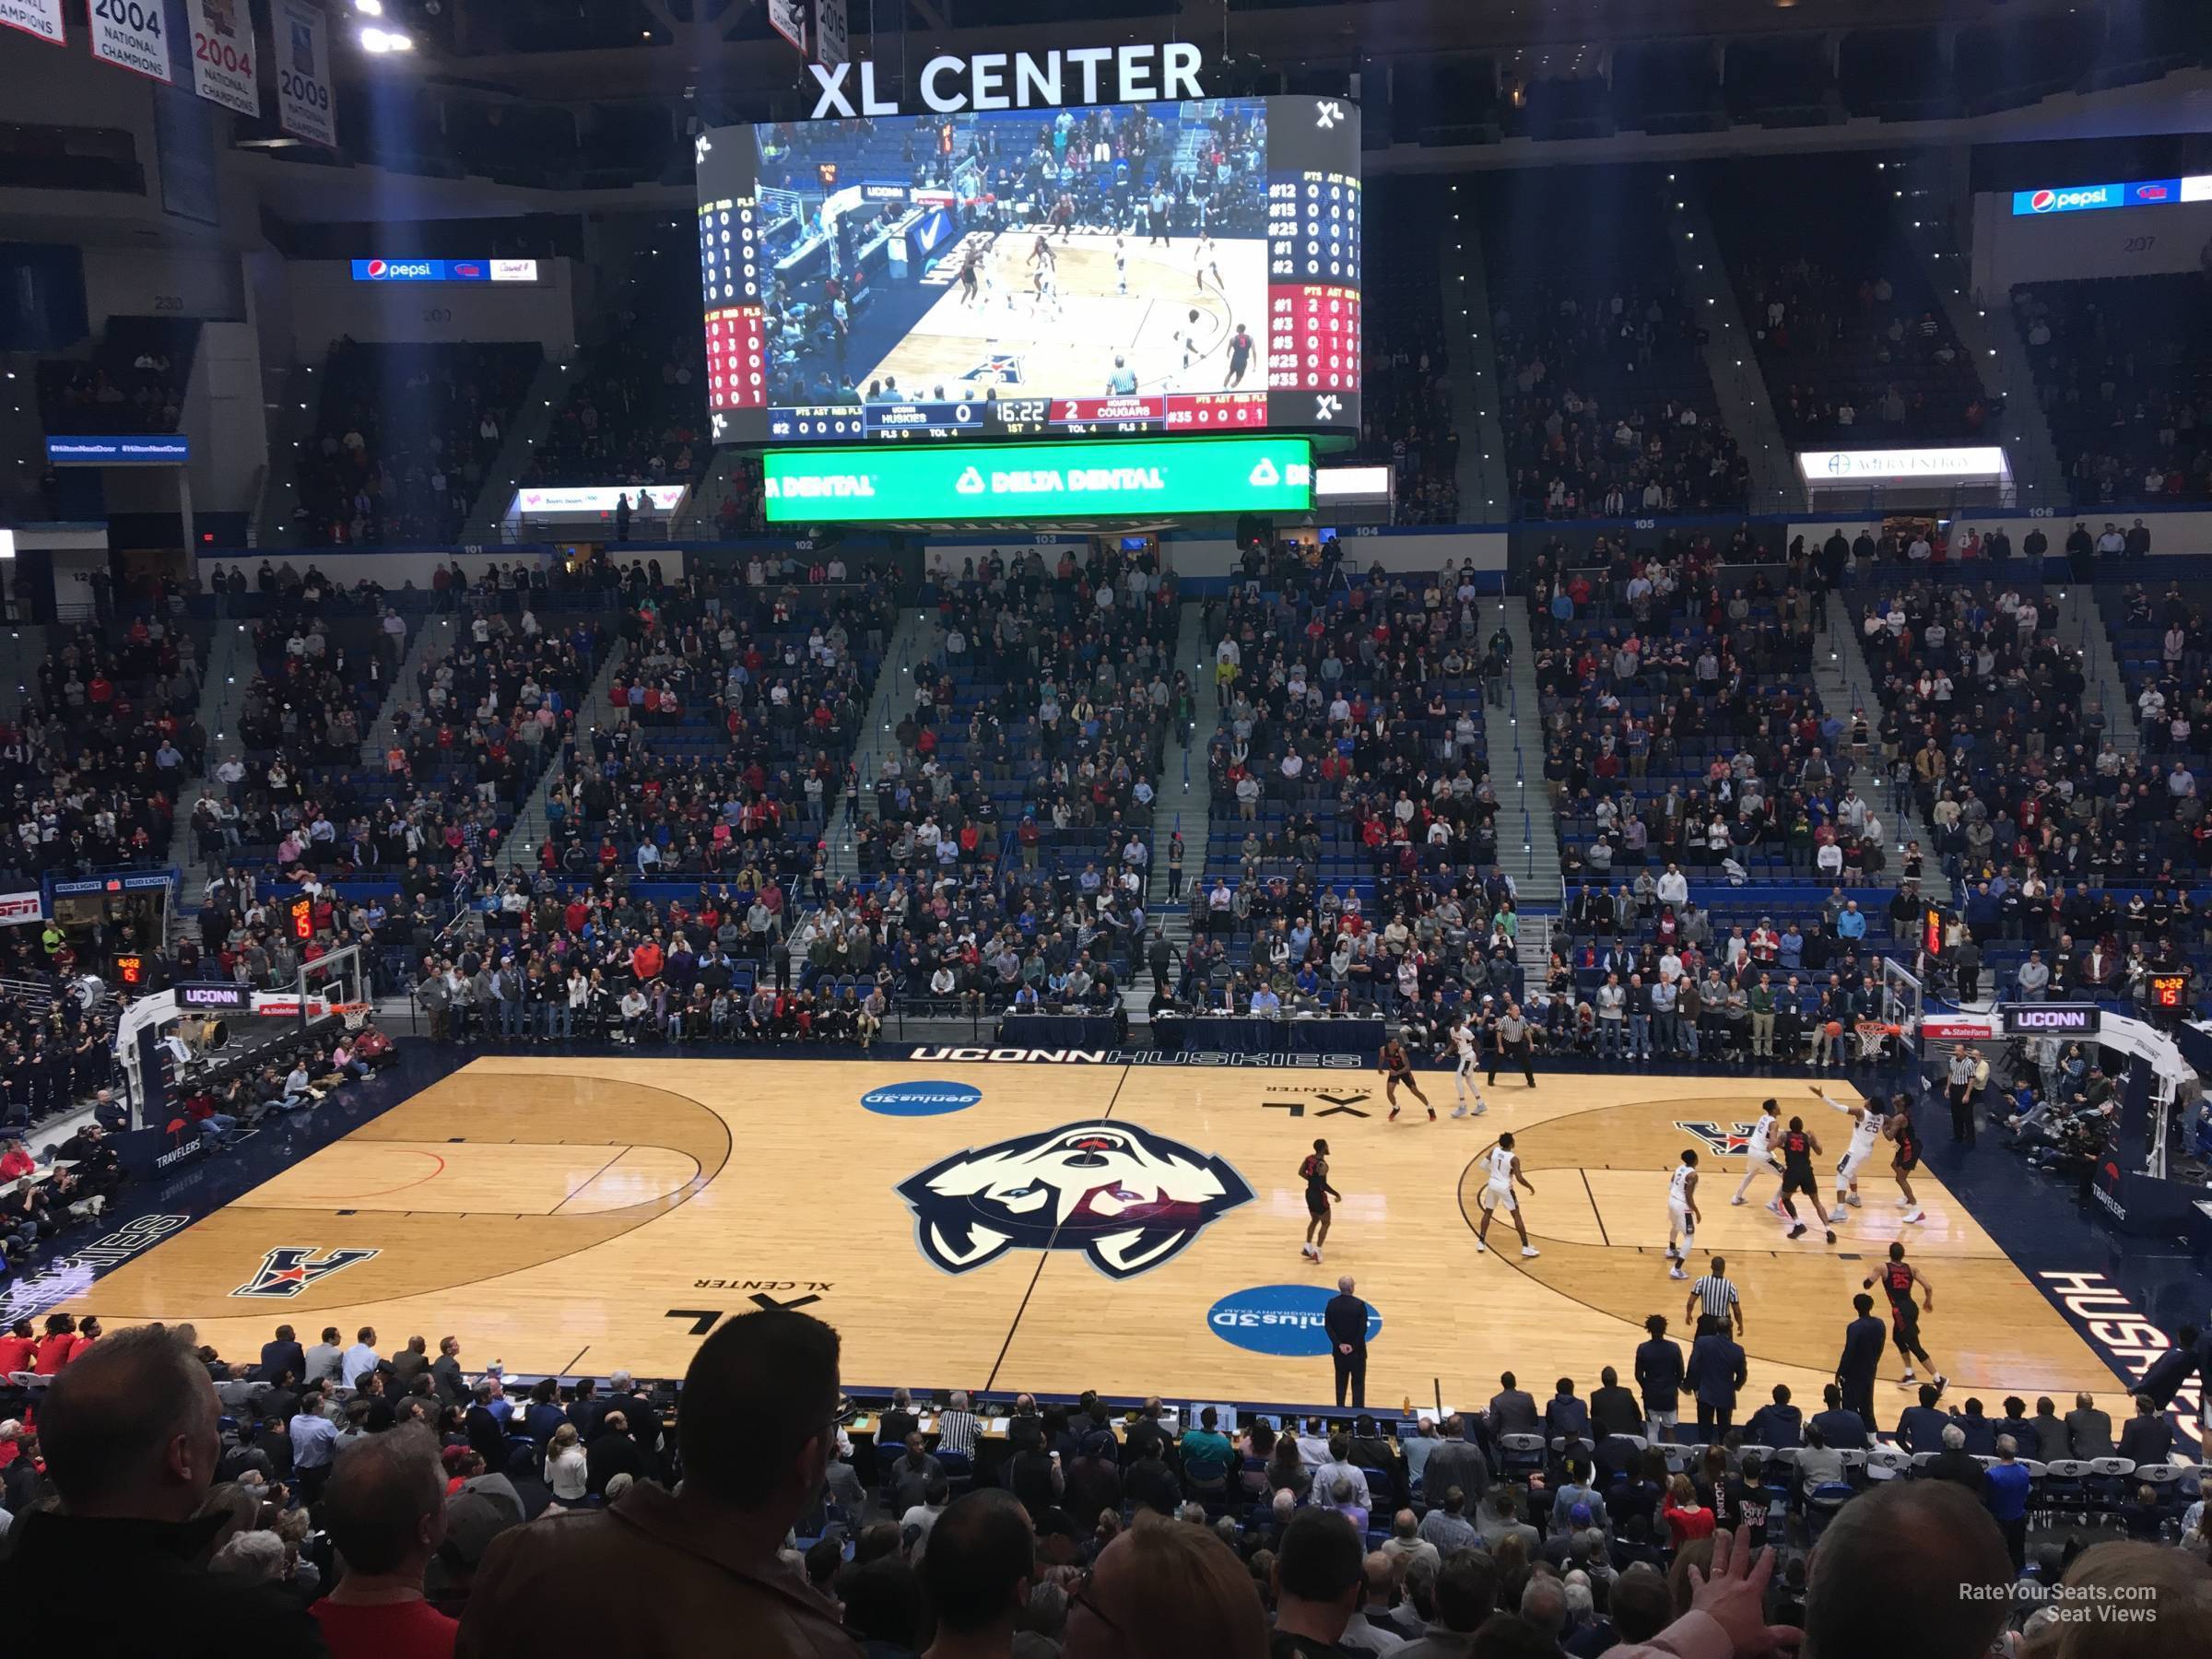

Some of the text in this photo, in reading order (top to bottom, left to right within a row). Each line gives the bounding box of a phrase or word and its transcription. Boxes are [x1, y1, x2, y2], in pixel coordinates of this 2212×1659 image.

[96, 0, 161, 39] 2004
[104, 26, 158, 56] NATIONAL
[102, 43, 164, 76] CHAMPIONS
[195, 32, 252, 78] 2004
[205, 68, 249, 94] NATIONAL
[807, 61, 899, 119] XL
[920, 42, 1206, 113] CENTER
[281, 70, 328, 111] 2009
[202, 84, 254, 112] CHAMPIONS
[1316, 100, 1344, 128] XL
[1304, 171, 1343, 183] PTS AST
[1269, 184, 1319, 198] #12 0
[737, 197, 754, 207] FLS
[2057, 188, 2107, 209] pepsi
[1269, 203, 1319, 218] #15 0
[1268, 222, 1319, 236] #25 0
[1275, 241, 1319, 255] #1 0
[2124, 236, 2156, 252] 207
[390, 263, 431, 278] pepsi
[1273, 260, 1319, 274] #2 0
[1304, 287, 1342, 298] PTS AST
[744, 307, 760, 317] FLS
[1275, 299, 1318, 312] #1 2
[749, 319, 756, 332] 1
[1273, 317, 1293, 331] #3
[1273, 335, 1337, 350] #5 1
[1269, 354, 1298, 368] #25
[1269, 372, 1298, 386] #35
[753, 390, 760, 404] 1
[1107, 399, 1140, 407] HOUSTON
[1196, 395, 1211, 405] PTS
[1215, 395, 1230, 404] AST
[1252, 394, 1267, 403] FLS
[795, 408, 810, 417] PTS
[813, 408, 828, 417] AST
[956, 405, 971, 422] 0
[996, 402, 1043, 422] 16:22
[1065, 402, 1077, 419] 2
[1097, 406, 1150, 418] COUGARS
[1316, 394, 1342, 420] XL
[881, 413, 927, 424] HUSKIES
[1168, 409, 1263, 424] #35 0 0 0 1
[772, 421, 861, 434] #2 0 0
[881, 429, 910, 439] FLS 0
[929, 428, 959, 437] TOL 4
[1007, 424, 1023, 433] 1ST
[1067, 424, 1097, 434] TOL 4
[1119, 422, 1147, 432] FLS 3
[783, 475, 875, 498] DENTAL
[992, 468, 1165, 493] DELTA DENTAL
[2029, 507, 2054, 517] 106
[1356, 526, 1379, 536] 104
[1634, 519, 1654, 529] 105
[794, 540, 813, 550] 102
[1035, 535, 1056, 544] 103
[464, 545, 483, 554] 101
[76, 881, 100, 890] LIGHT
[145, 877, 169, 885] LIGHT
[298, 915, 309, 936] 15
[124, 969, 137, 982] 15
[2154, 978, 2183, 990] 16:22
[186, 990, 238, 1003] UCONN
[2161, 991, 2175, 1005] 15
[2018, 1012, 2085, 1027] UCONN
[910, 1047, 1362, 1068] UCONN HUSKIES
[865, 1095, 974, 1104] genius3D
[1262, 1094, 1371, 1118] XL
[1865, 1121, 1880, 1134] 25
[156, 1138, 200, 1169] TRAVELERS
[1497, 1159, 1502, 1171] 1
[2091, 1182, 2126, 1221] TRAVELERS
[693, 1279, 836, 1290] XL CENTER
[1213, 1312, 1325, 1329] nius3D
